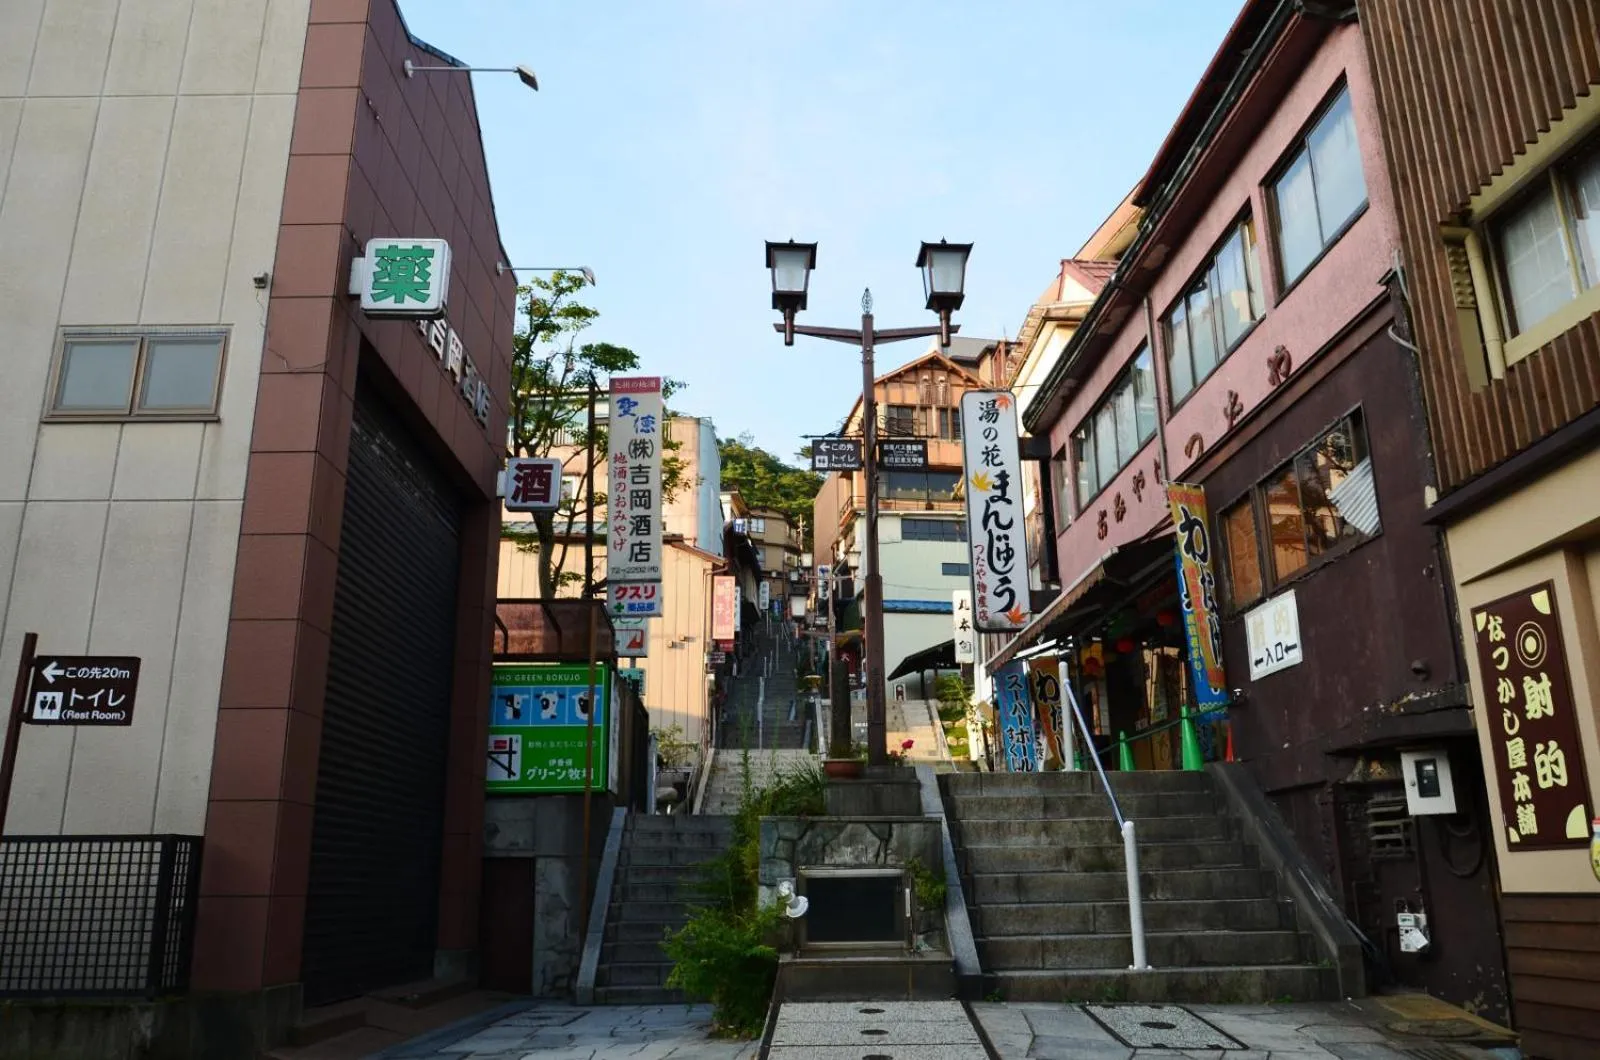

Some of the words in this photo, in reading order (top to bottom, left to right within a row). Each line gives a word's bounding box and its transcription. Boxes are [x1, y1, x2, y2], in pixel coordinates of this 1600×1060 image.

[371, 245, 435, 304] 薬
[832, 443, 854, 451] この先
[832, 452, 856, 462] トイレ
[511, 463, 552, 504] 酒
[612, 452, 628, 551] 地酒のおみやげ
[615, 584, 657, 600] クスリ
[973, 544, 989, 622] つたや物産店
[1265, 641, 1284, 667] 入口
[65, 667, 130, 679] この先20m
[514, 673, 543, 681] GREEN
[546, 673, 581, 681] BOKUJO
[70, 688, 126, 707] トイレ
[61, 710, 90, 720] (Rest
[92, 710, 126, 720] Room)
[1487, 615, 1538, 835] なつかし屋本舗
[1522, 672, 1568, 790] 射的
